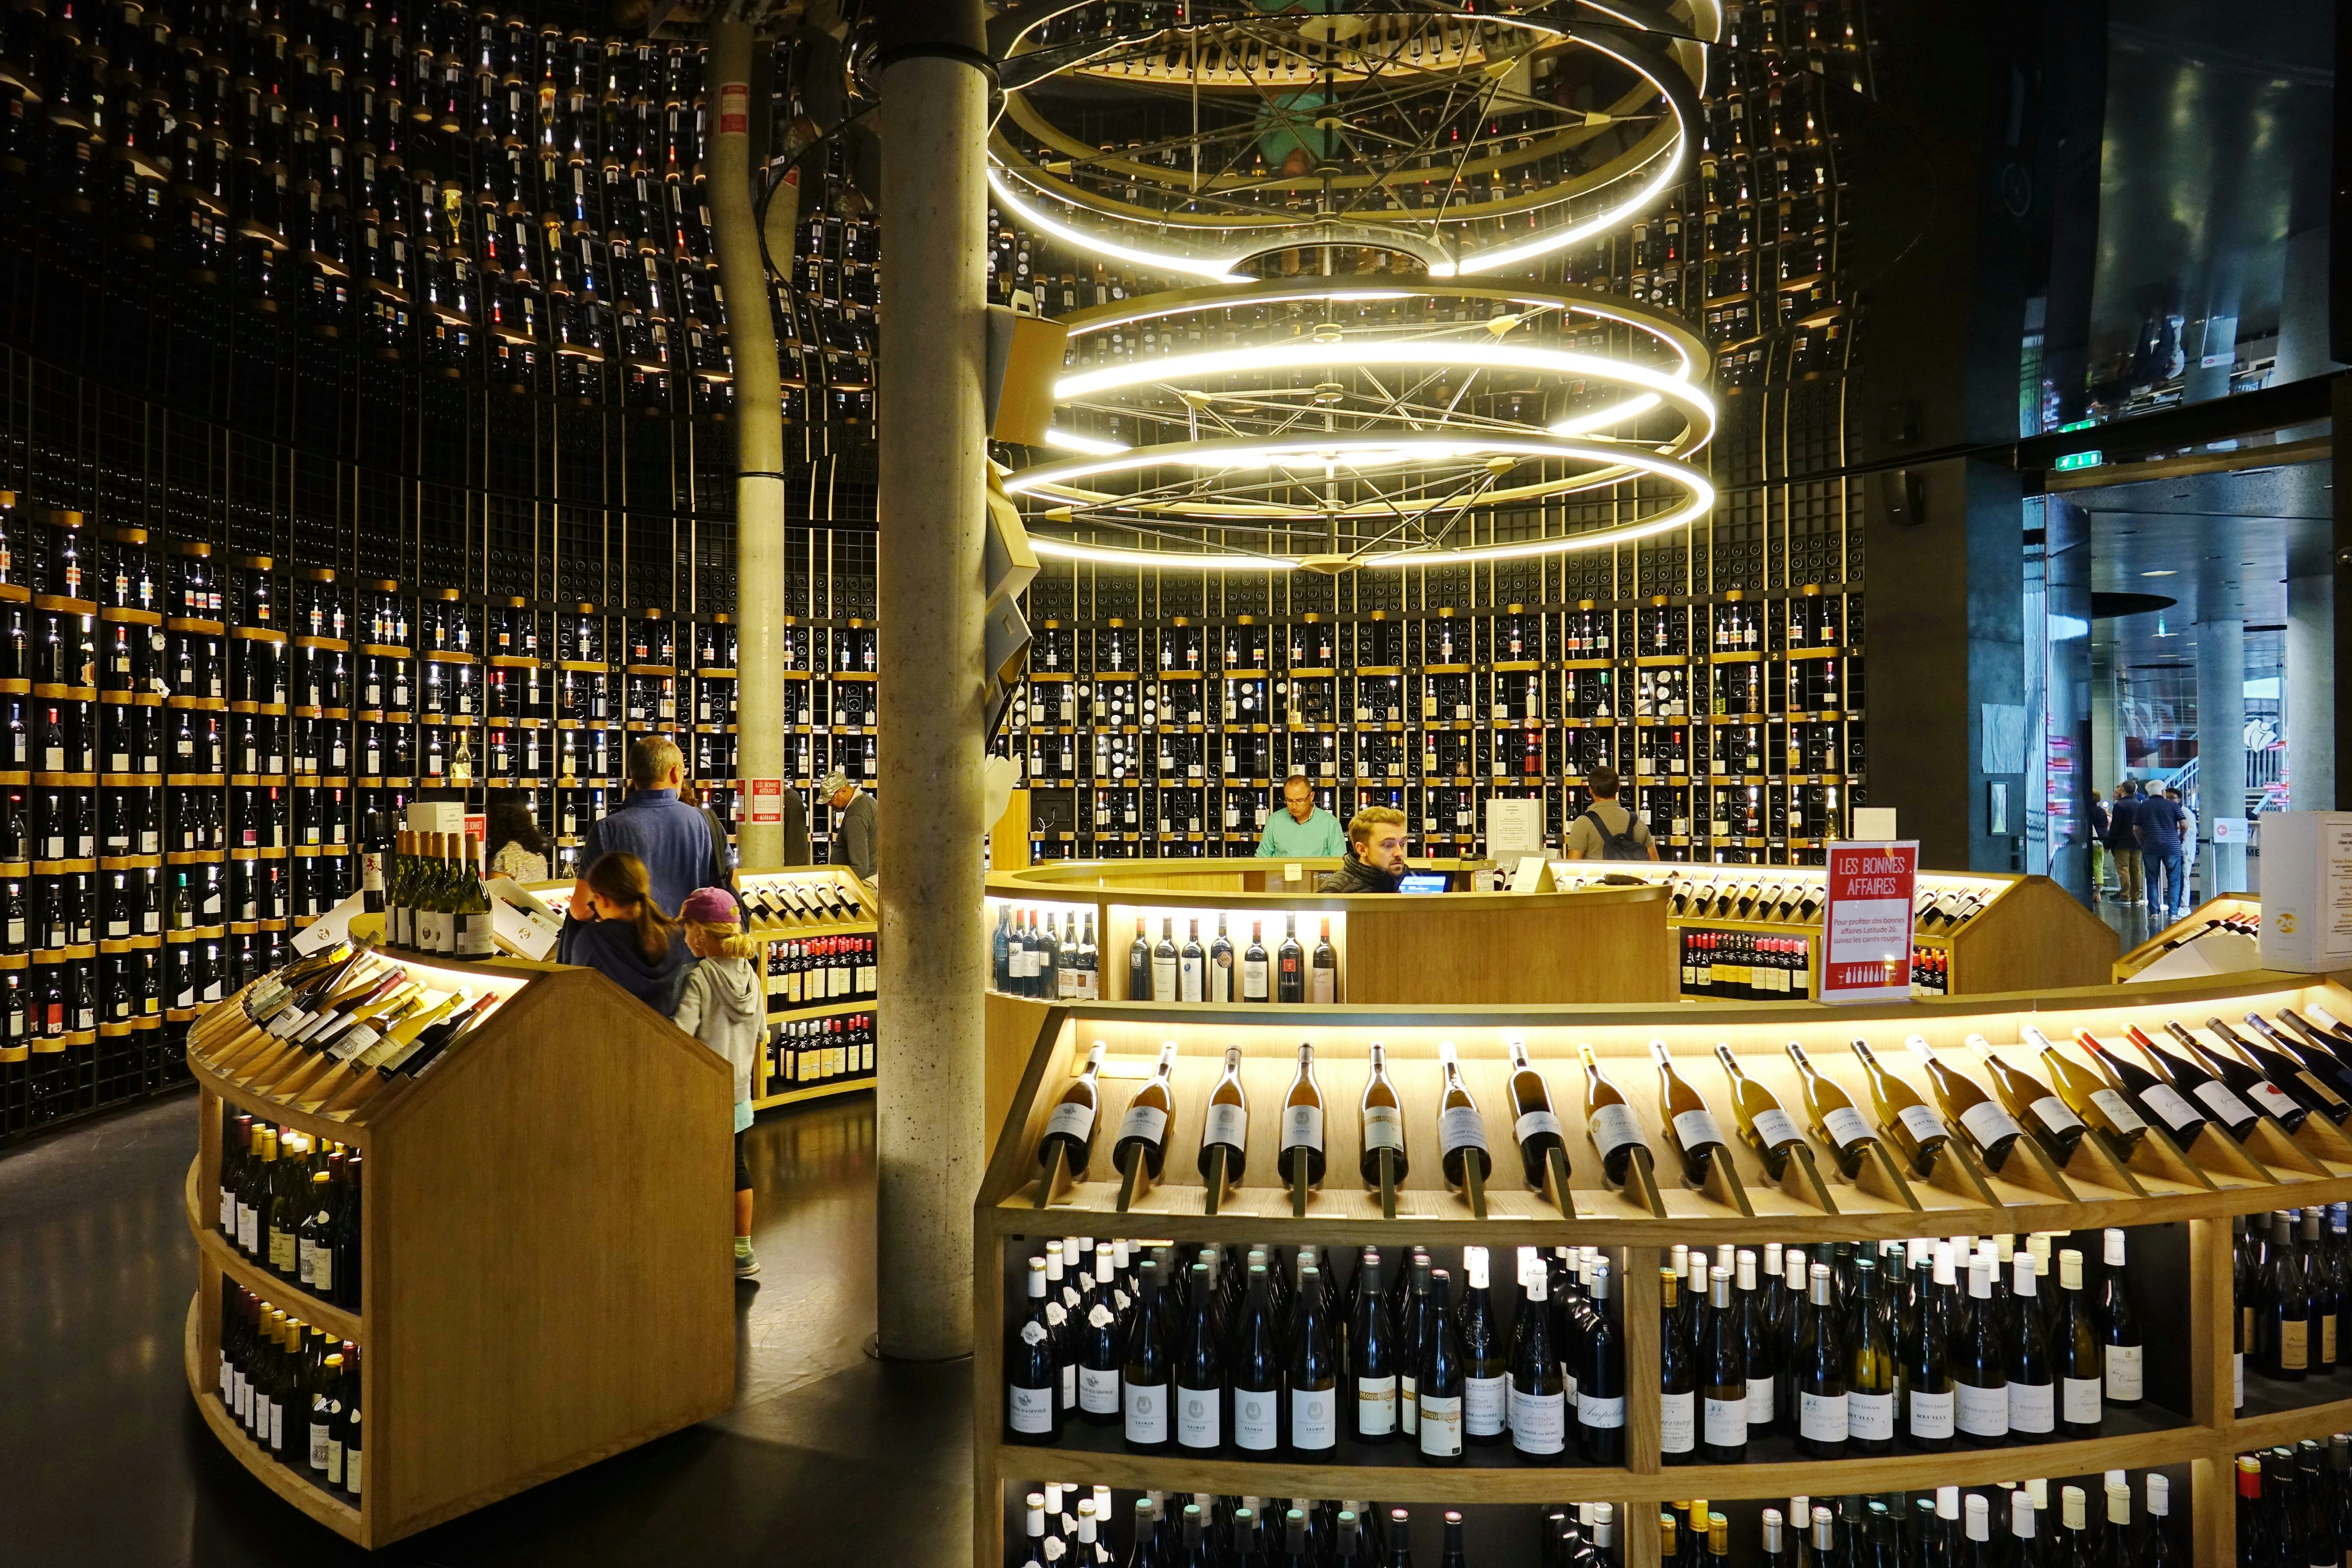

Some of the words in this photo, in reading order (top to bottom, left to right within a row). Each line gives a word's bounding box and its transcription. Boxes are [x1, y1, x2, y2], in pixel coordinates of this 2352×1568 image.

[469, 821, 482, 830] BONNES
[1839, 858, 1858, 875] LES
[1863, 856, 1905, 874] BONNES
[1847, 877, 1896, 895] AFFAIRES
[1849, 918, 1871, 926] profiter
